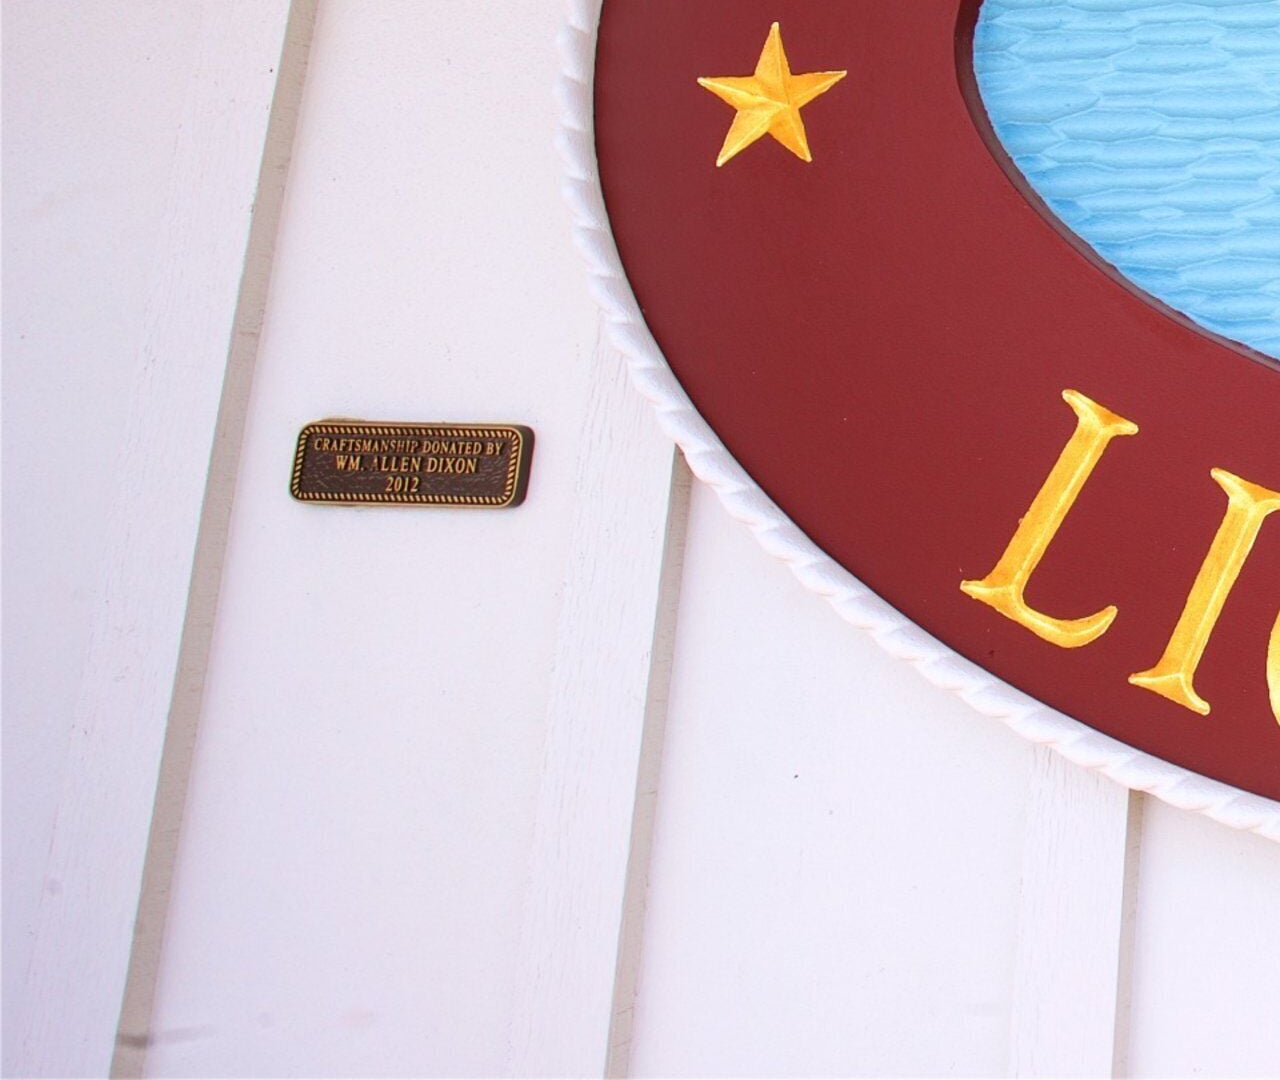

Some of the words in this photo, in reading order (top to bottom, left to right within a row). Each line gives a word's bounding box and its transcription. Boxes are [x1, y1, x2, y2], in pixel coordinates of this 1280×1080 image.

[314, 437, 419, 454] CRAFTSMANSHIP
[422, 439, 482, 455] DONATED
[486, 441, 503, 456] BY
[335, 455, 365, 471] WM.
[371, 455, 421, 472] ALLEN
[427, 456, 478, 474] DIXON
[385, 476, 420, 493] 2012
